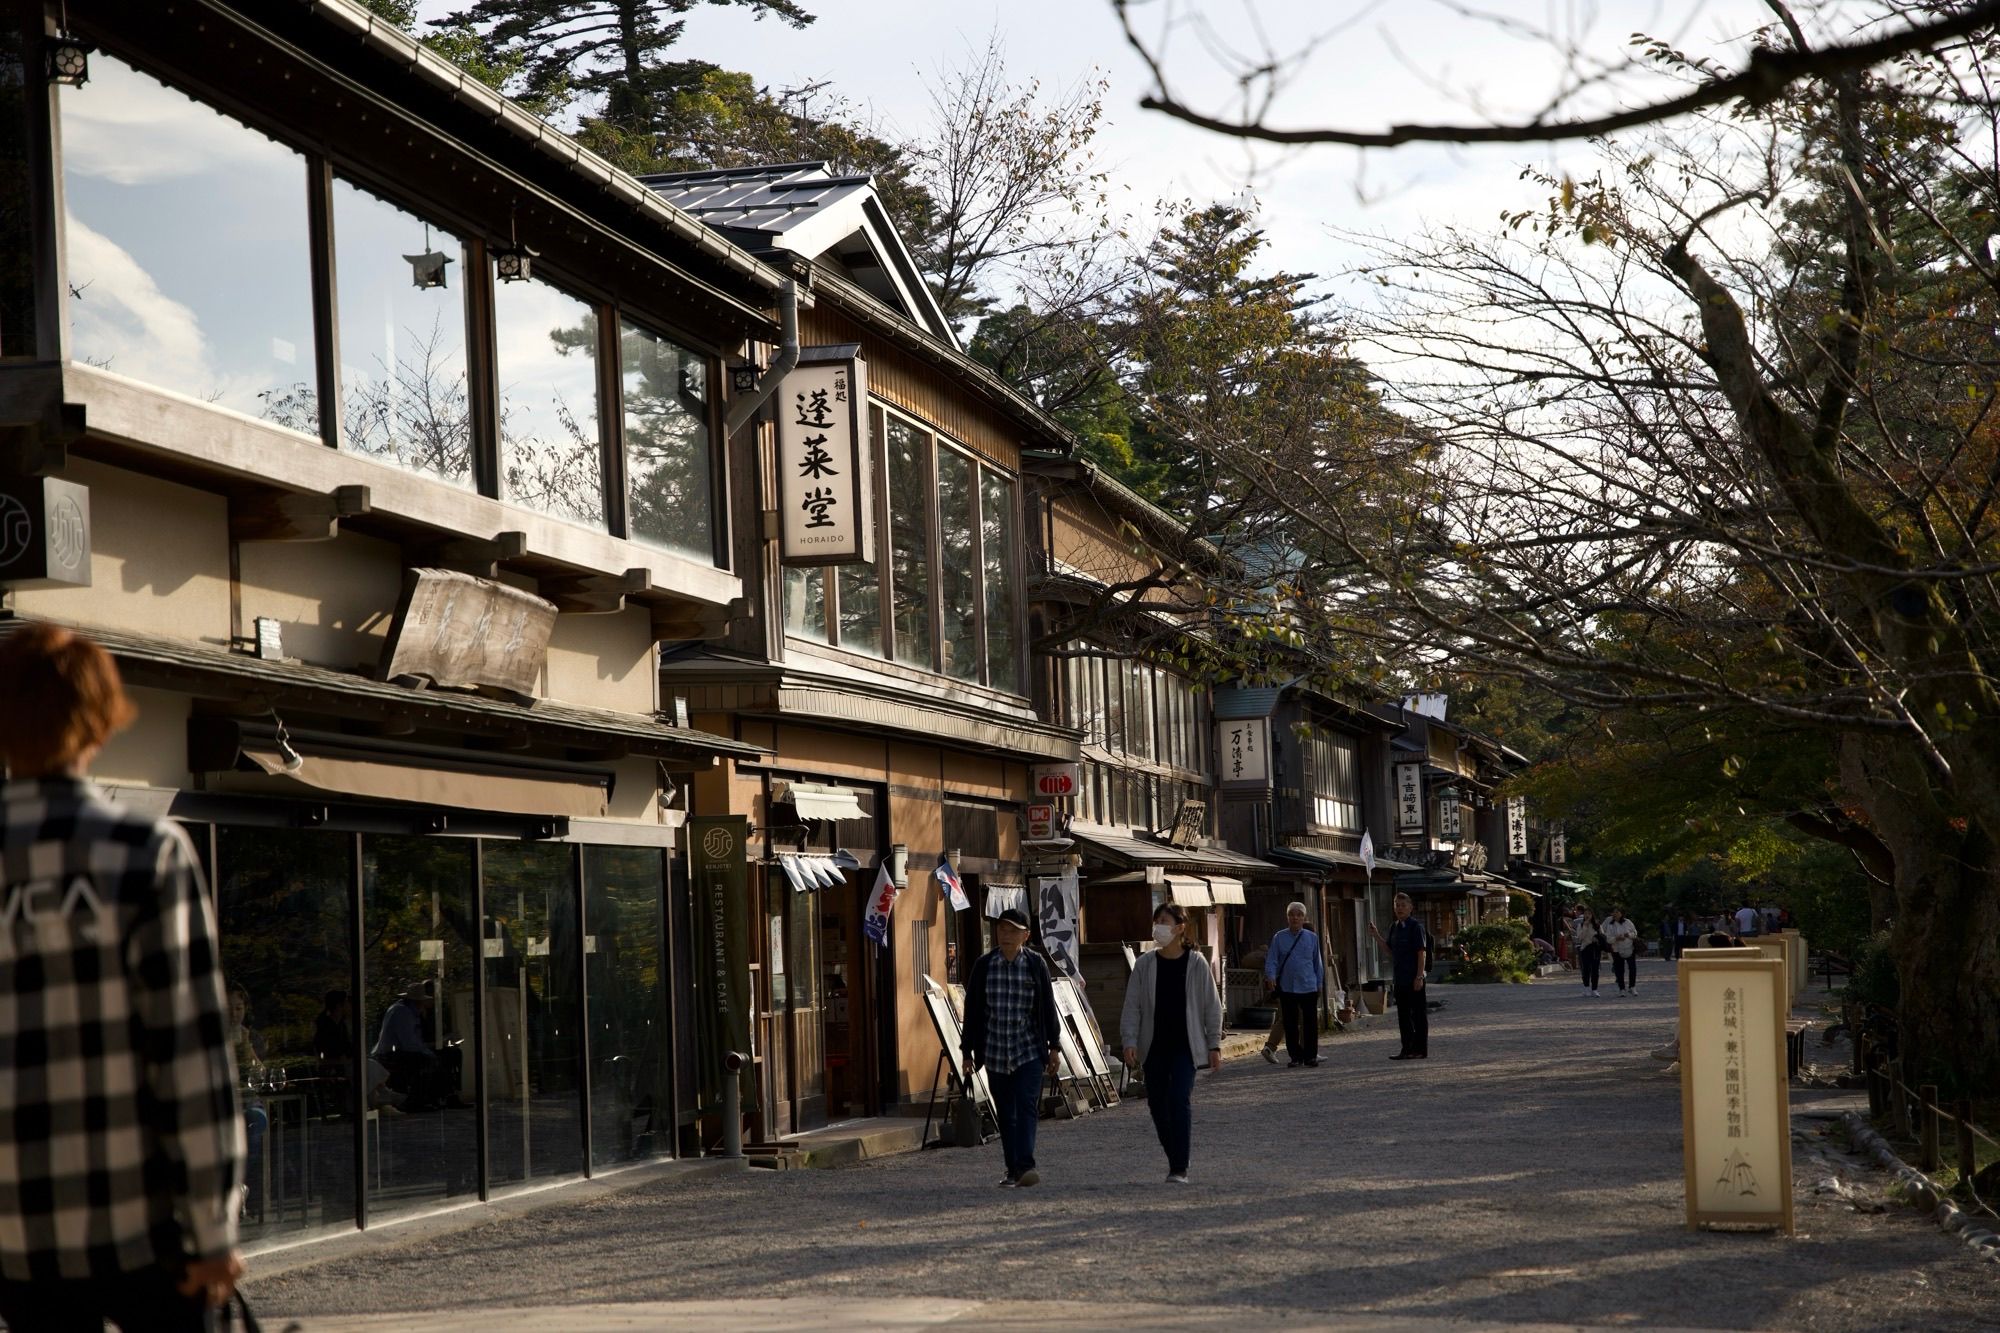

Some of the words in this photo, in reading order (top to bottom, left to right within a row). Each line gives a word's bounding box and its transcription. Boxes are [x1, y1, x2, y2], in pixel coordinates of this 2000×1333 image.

[834, 370, 847, 402] 一福処
[795, 388, 840, 529] 蓬莱堂
[800, 535, 844, 544] HORAIDO
[714, 884, 725, 964] RESTAURANT
[717, 969, 726, 977] &
[717, 982, 728, 1013] CAFÉ
